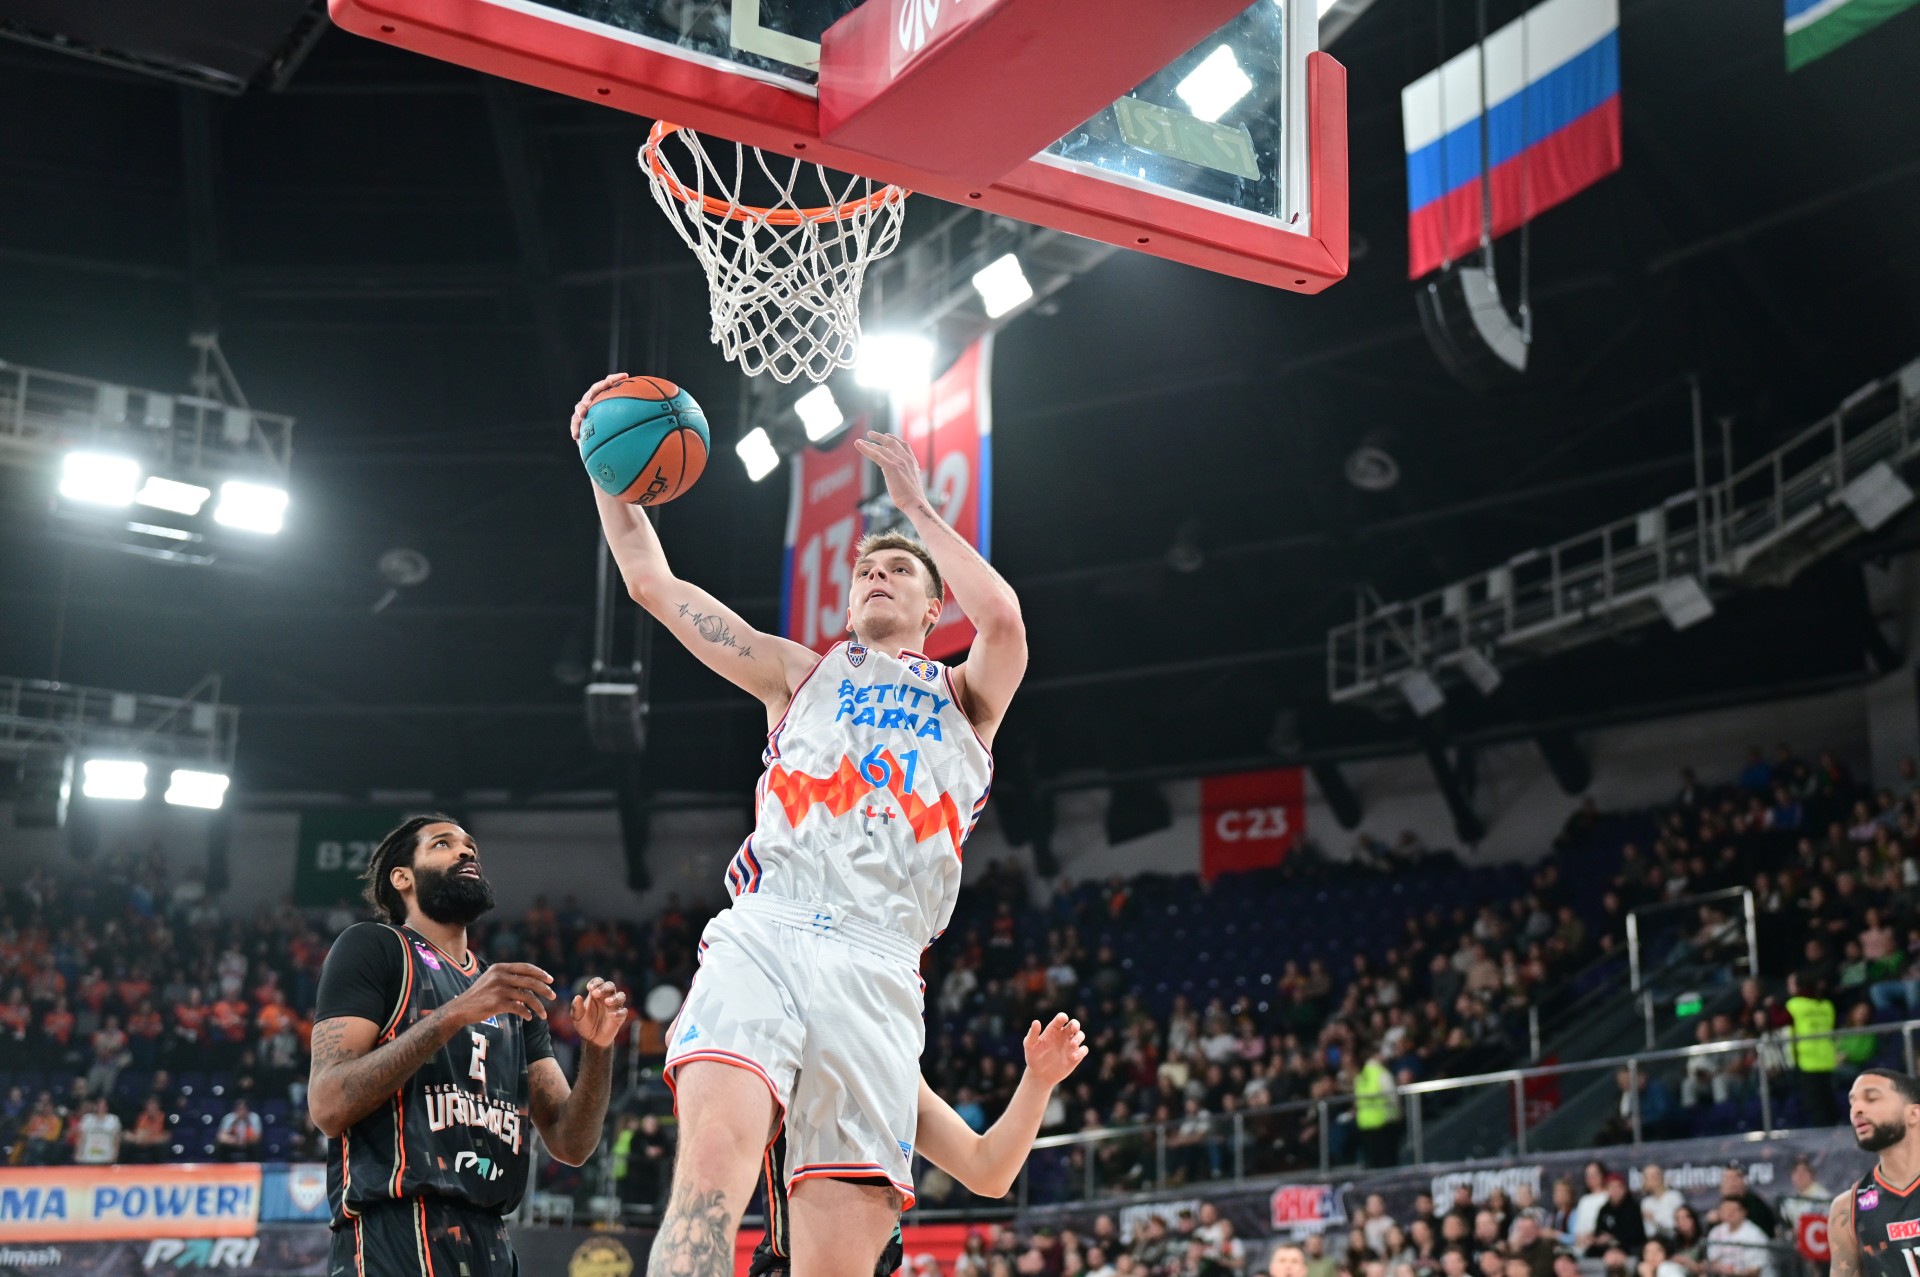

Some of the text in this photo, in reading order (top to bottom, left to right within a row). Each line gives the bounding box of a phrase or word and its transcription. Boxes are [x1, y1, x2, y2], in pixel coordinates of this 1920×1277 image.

[801, 517, 855, 648] 13
[859, 743, 918, 795] 61
[1216, 806, 1287, 841] C23
[469, 1032, 487, 1082] 2
[92, 1184, 254, 1218] POWER!
[0, 1246, 61, 1267] lmash
[142, 1237, 260, 1269] PARI
